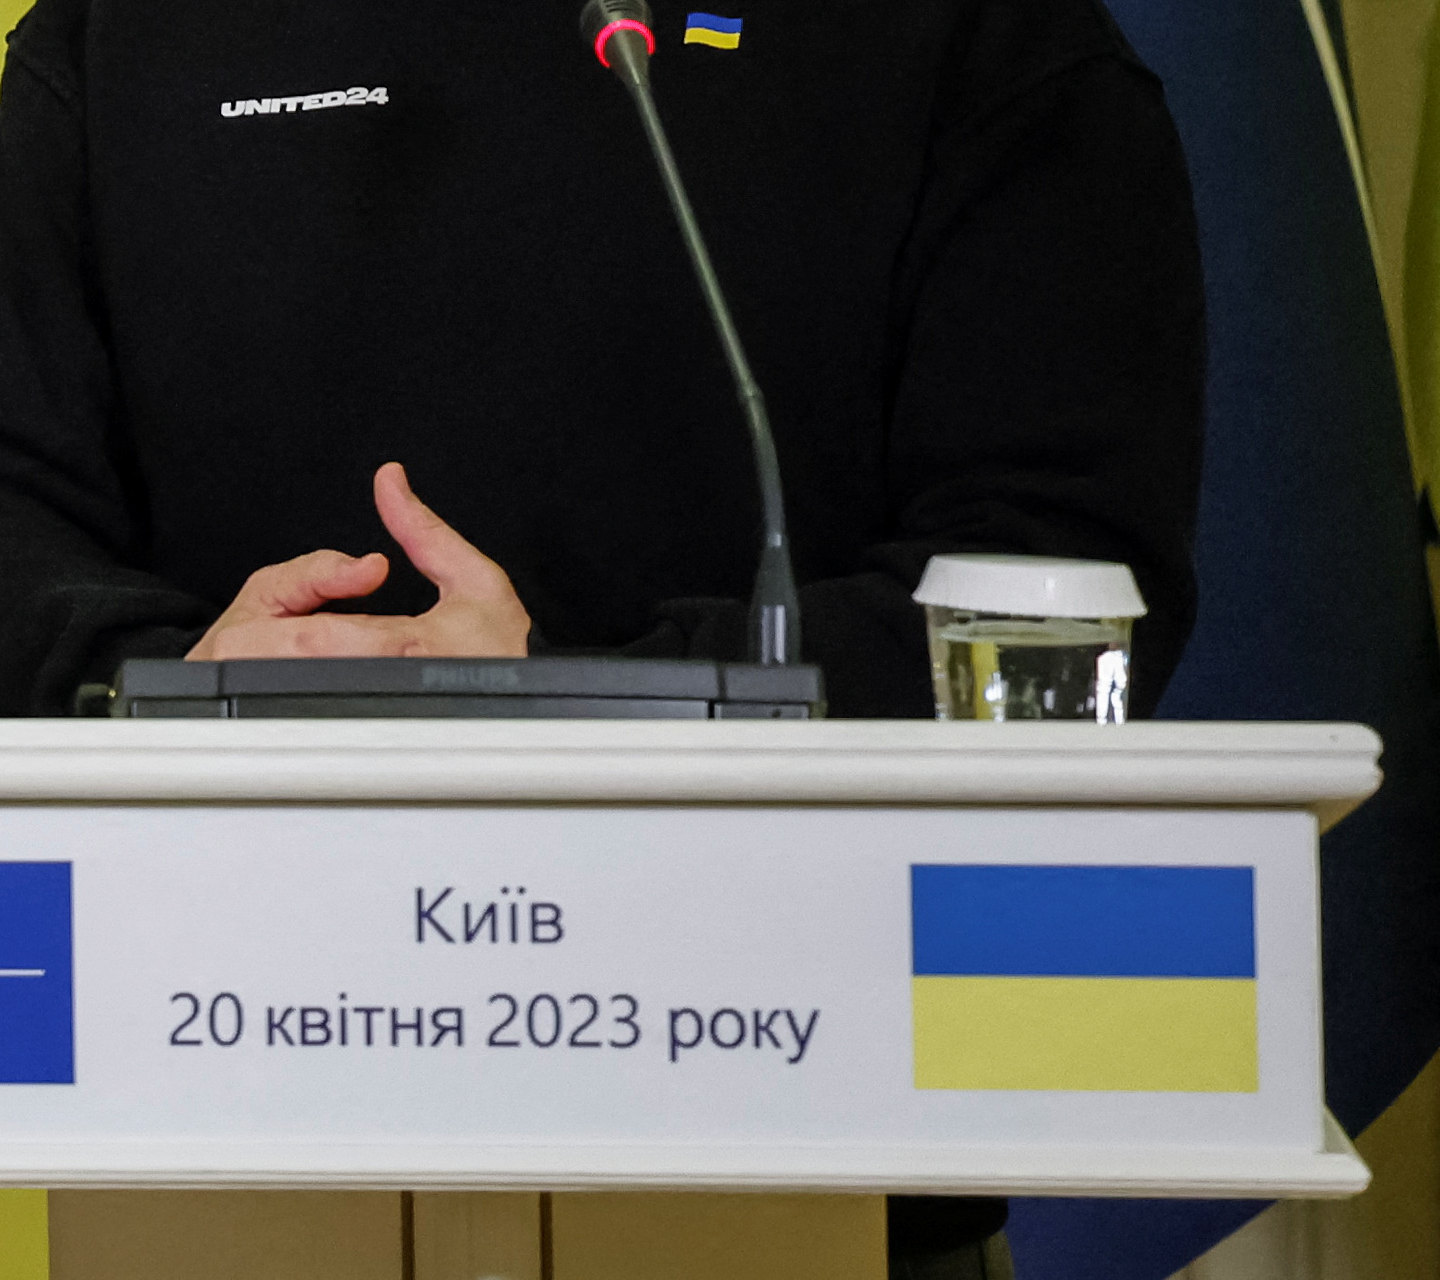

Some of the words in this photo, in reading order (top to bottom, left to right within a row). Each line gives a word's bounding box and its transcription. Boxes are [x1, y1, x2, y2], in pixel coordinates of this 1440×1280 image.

[220, 86, 390, 118] UNITED24
[414, 885, 566, 945] Київ
[168, 991, 245, 1048] 20
[266, 991, 465, 1048] квітня
[485, 992, 643, 1050] 2023
[667, 1006, 822, 1066] року
